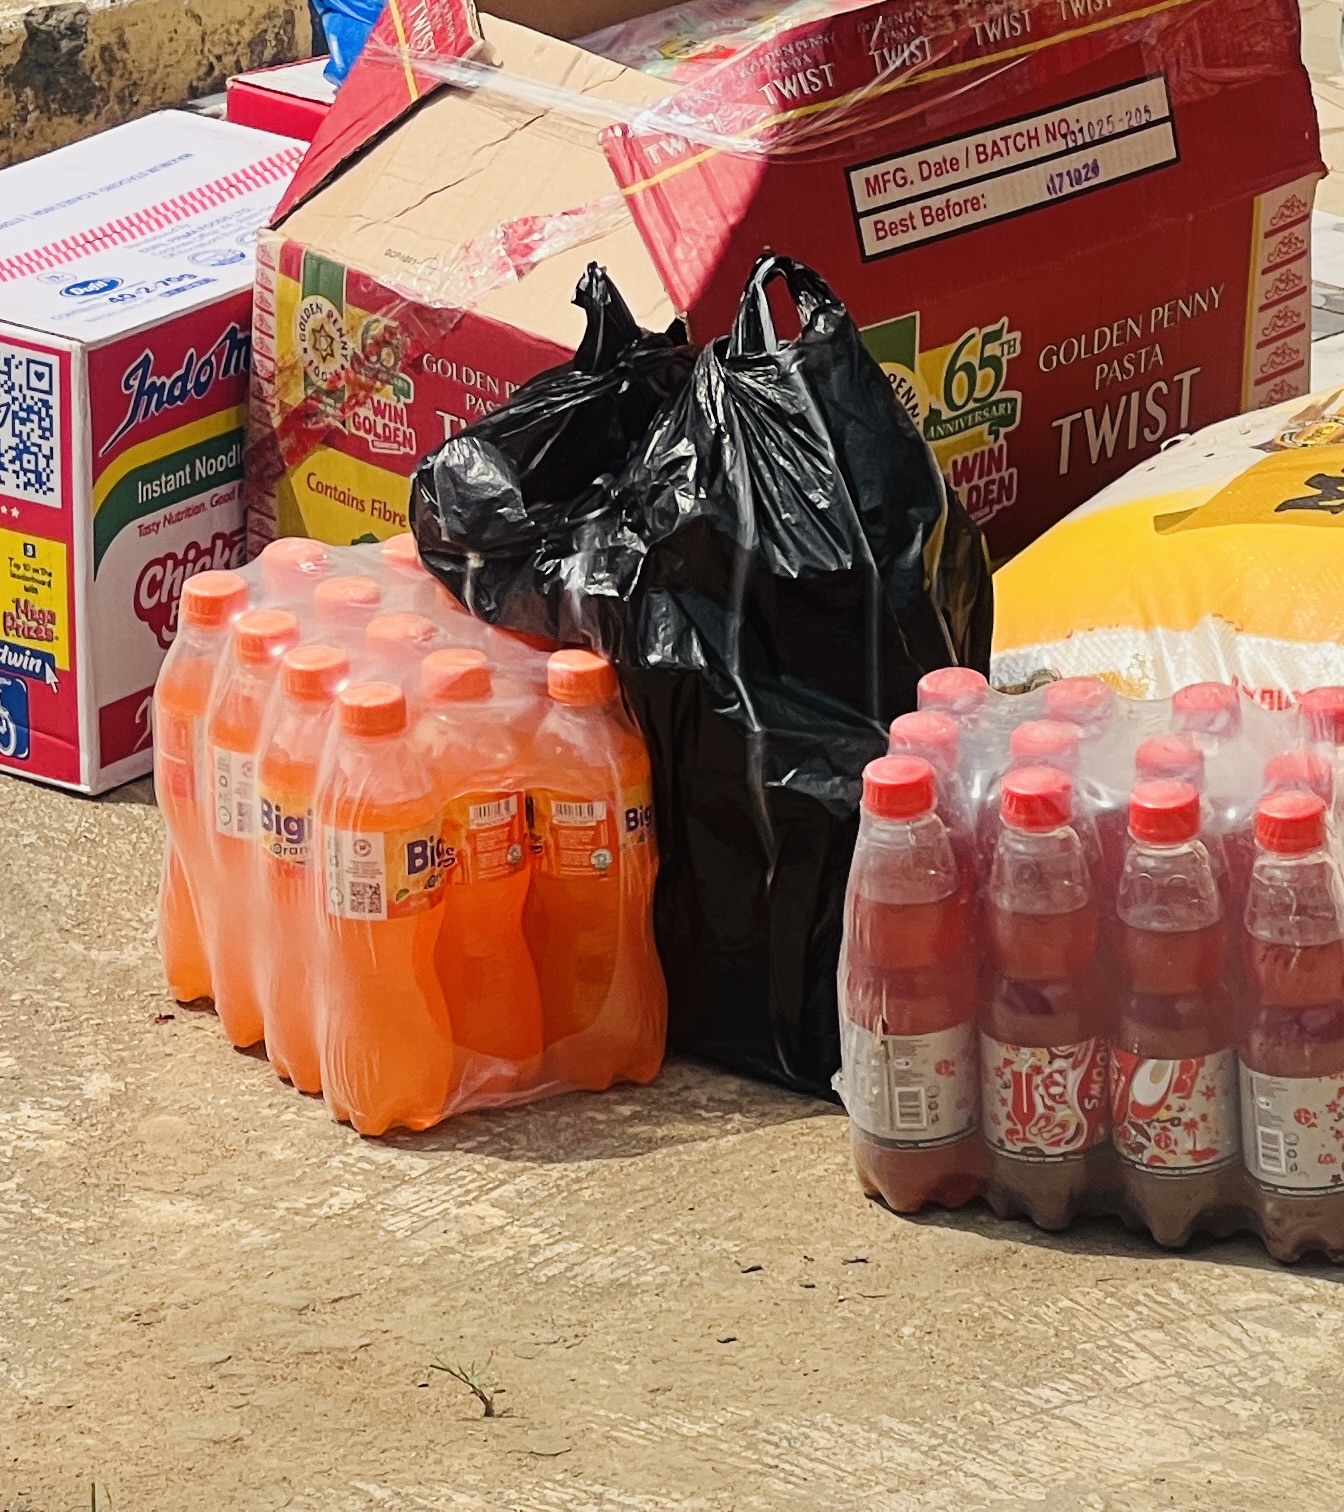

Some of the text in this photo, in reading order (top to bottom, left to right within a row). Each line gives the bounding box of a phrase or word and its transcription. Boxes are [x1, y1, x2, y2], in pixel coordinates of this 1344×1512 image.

[970, 9, 1032, 47] TWIST
[869, 36, 933, 75] TWIST
[758, 63, 834, 107] TWIST
[864, 173, 915, 198] MFG.
[918, 155, 961, 182] Date
[975, 127, 1041, 165] BATCH
[874, 193, 987, 242] Best Before:
[299, 301, 324, 343] GOLDEN
[1039, 282, 1226, 373] GOLDEN PENNY
[99, 322, 251, 458] Indom
[422, 353, 500, 396] GOLDEN
[1095, 343, 1165, 391] PASTA
[372, 400, 405, 426] WIN
[888, 373, 920, 426] PENN
[927, 400, 1016, 438] ANNIVERSARY
[1052, 367, 1202, 476] TWIST
[352, 411, 416, 451] GOLDEN
[138, 444, 244, 504] Instant Noodl
[952, 443, 1005, 488] WIN
[137, 522, 161, 538] Tasty
[210, 488, 235, 507] Good
[306, 472, 407, 528] Contains Fibre
[966, 471, 1015, 515] DEN
[260, 796, 314, 845] Bigi
[625, 804, 653, 833] Big
